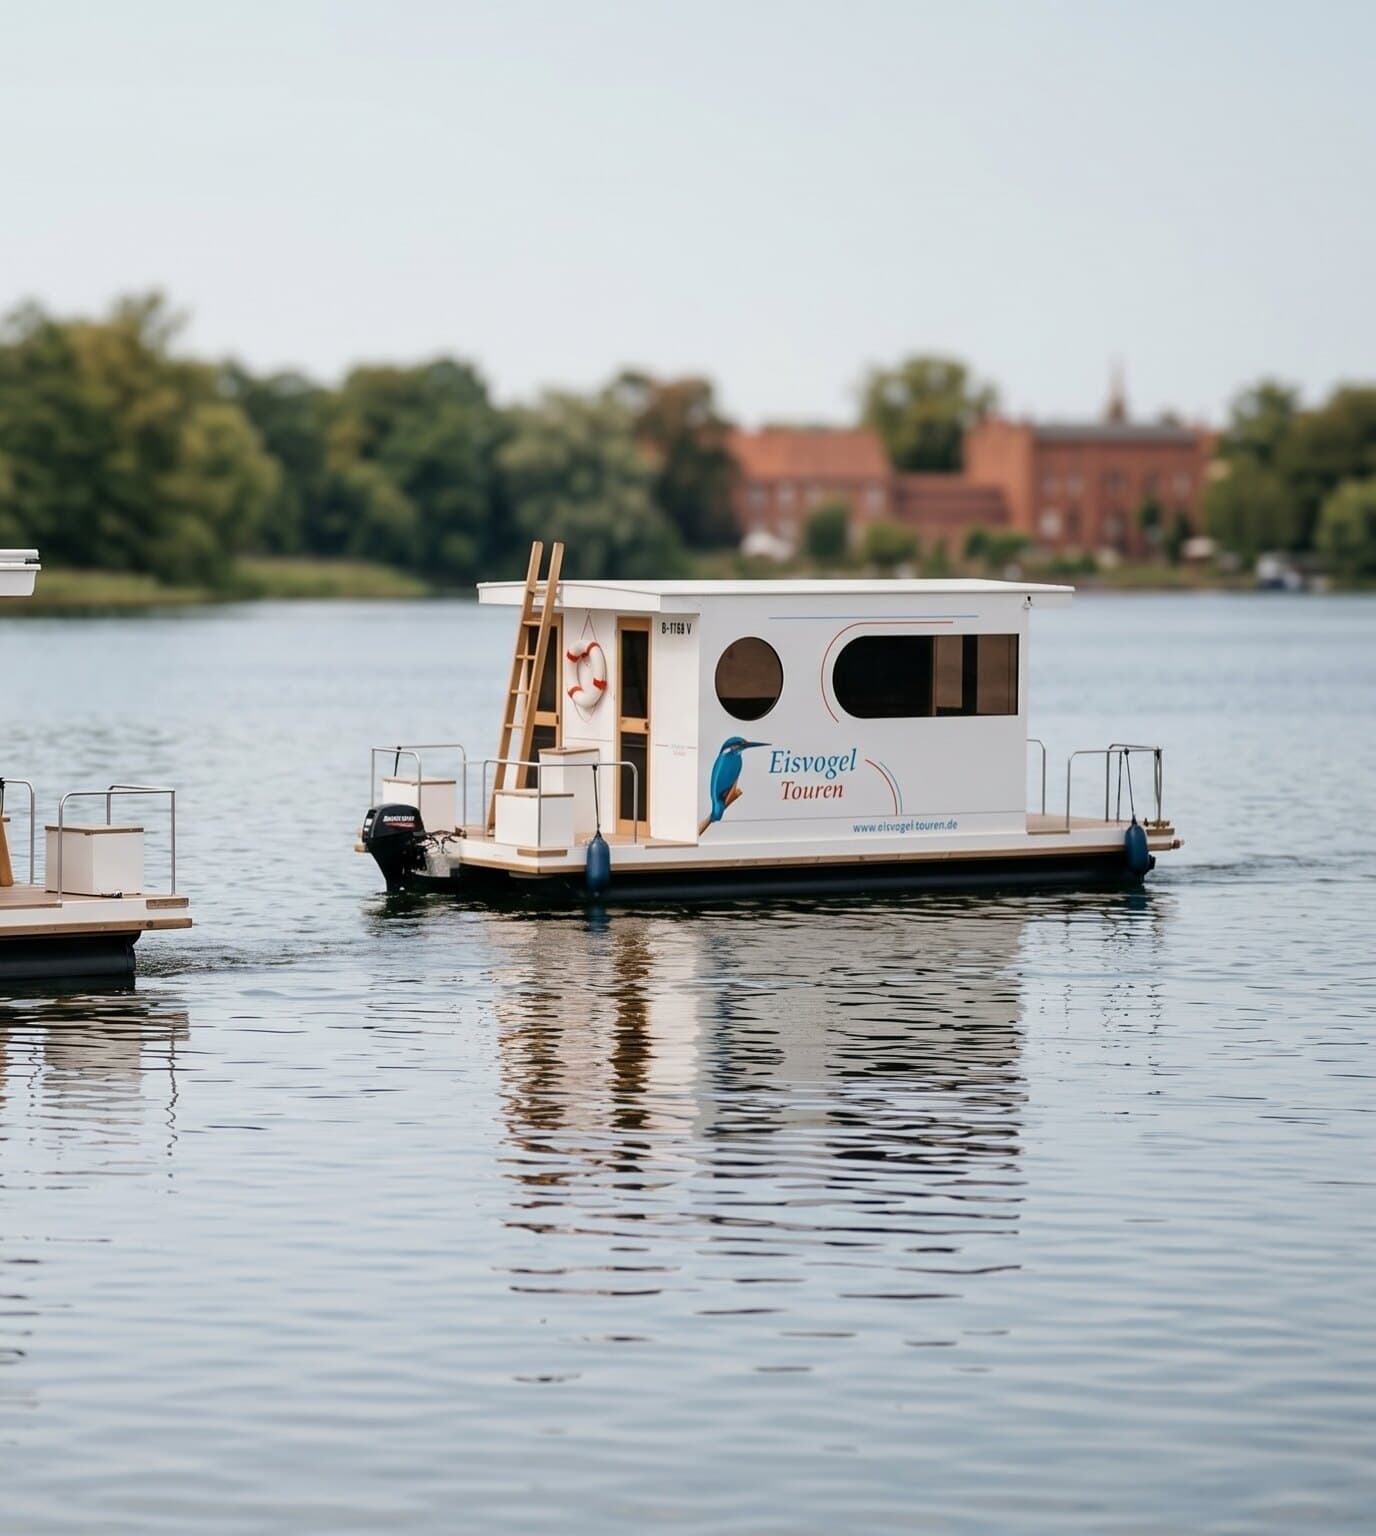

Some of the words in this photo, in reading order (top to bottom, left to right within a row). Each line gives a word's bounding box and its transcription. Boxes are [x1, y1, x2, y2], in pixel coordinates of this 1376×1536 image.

[686, 623, 692, 634] V
[769, 748, 856, 780] Eisvogel
[781, 781, 843, 800] Touren
[853, 819, 958, 833] www.eisvogeltouren.de
